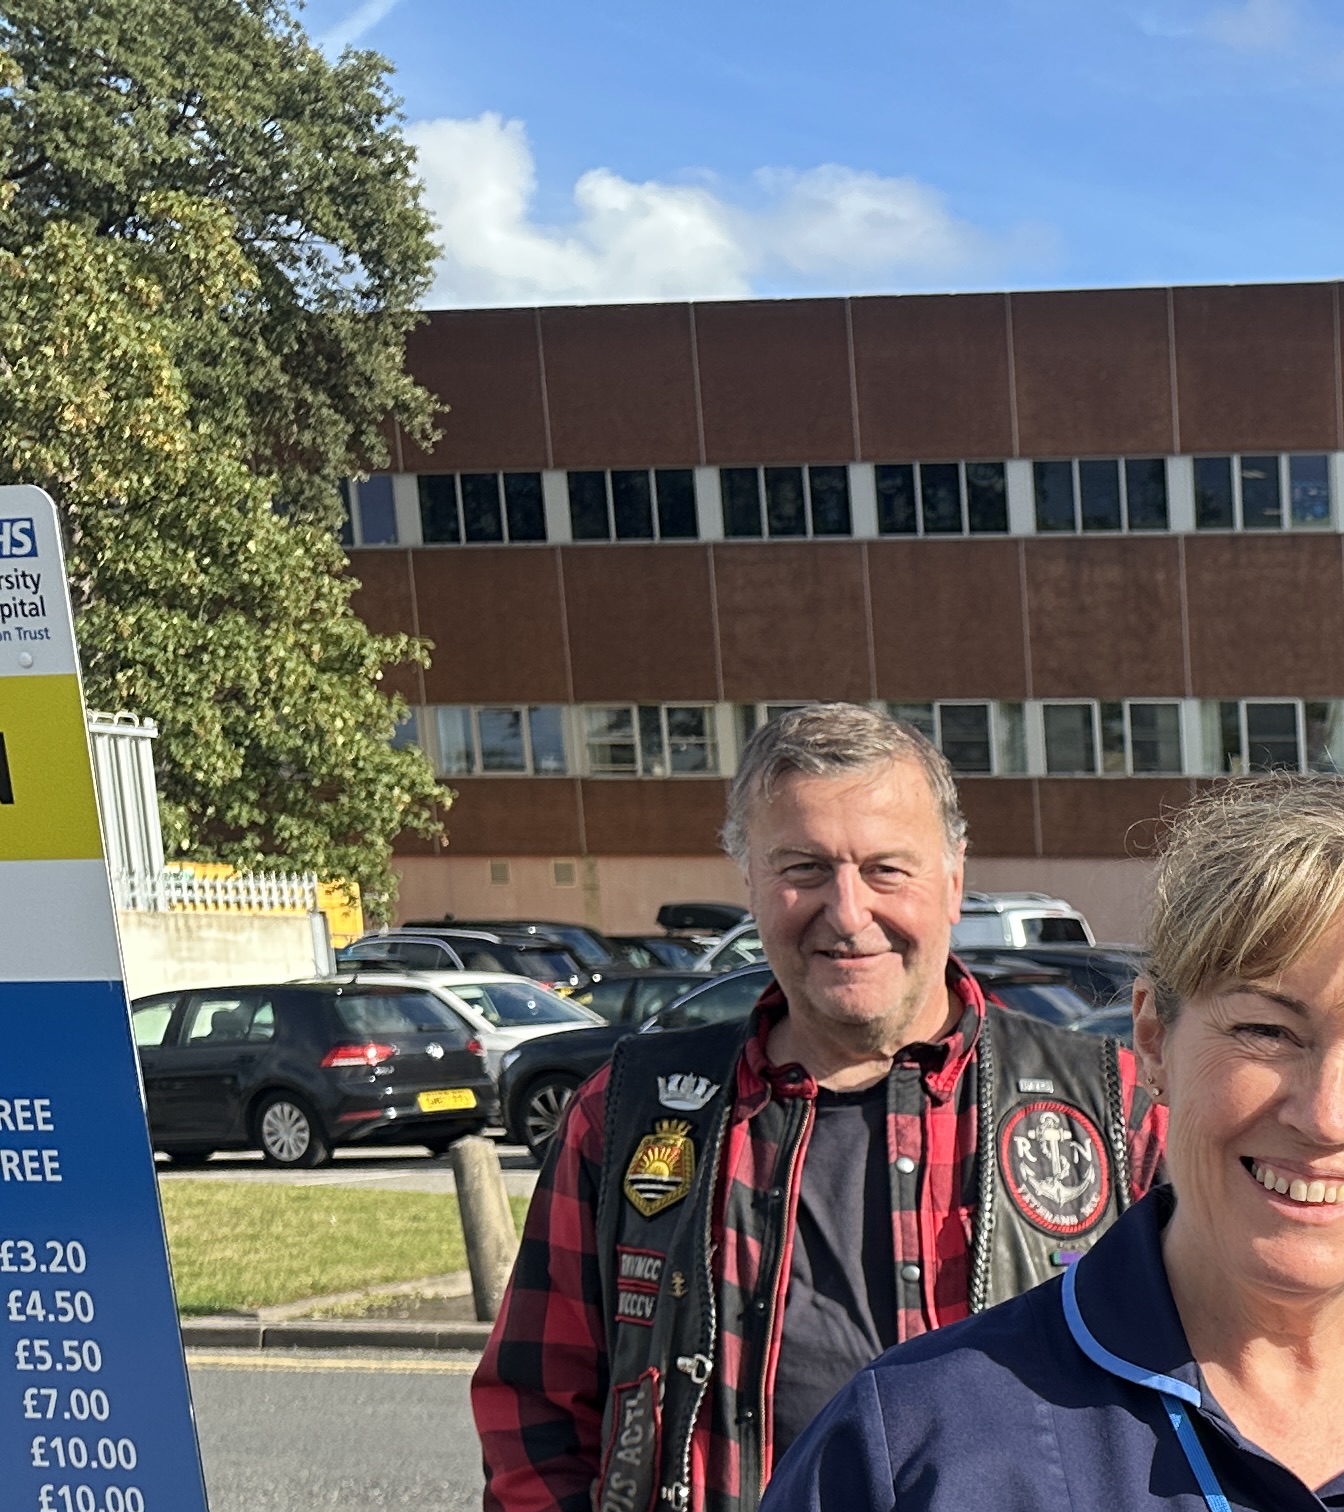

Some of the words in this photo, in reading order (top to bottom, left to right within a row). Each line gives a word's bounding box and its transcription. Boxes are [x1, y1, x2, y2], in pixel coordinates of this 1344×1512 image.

[15, 626, 50, 641] Trust
[1013, 1135, 1038, 1162] R
[1069, 1137, 1092, 1164] N
[0, 1240, 87, 1274] £3.20
[7, 1290, 95, 1324] £4.50
[15, 1338, 102, 1373] £5.50
[23, 1387, 110, 1421] £7.00
[31, 1436, 138, 1470] £10.00
